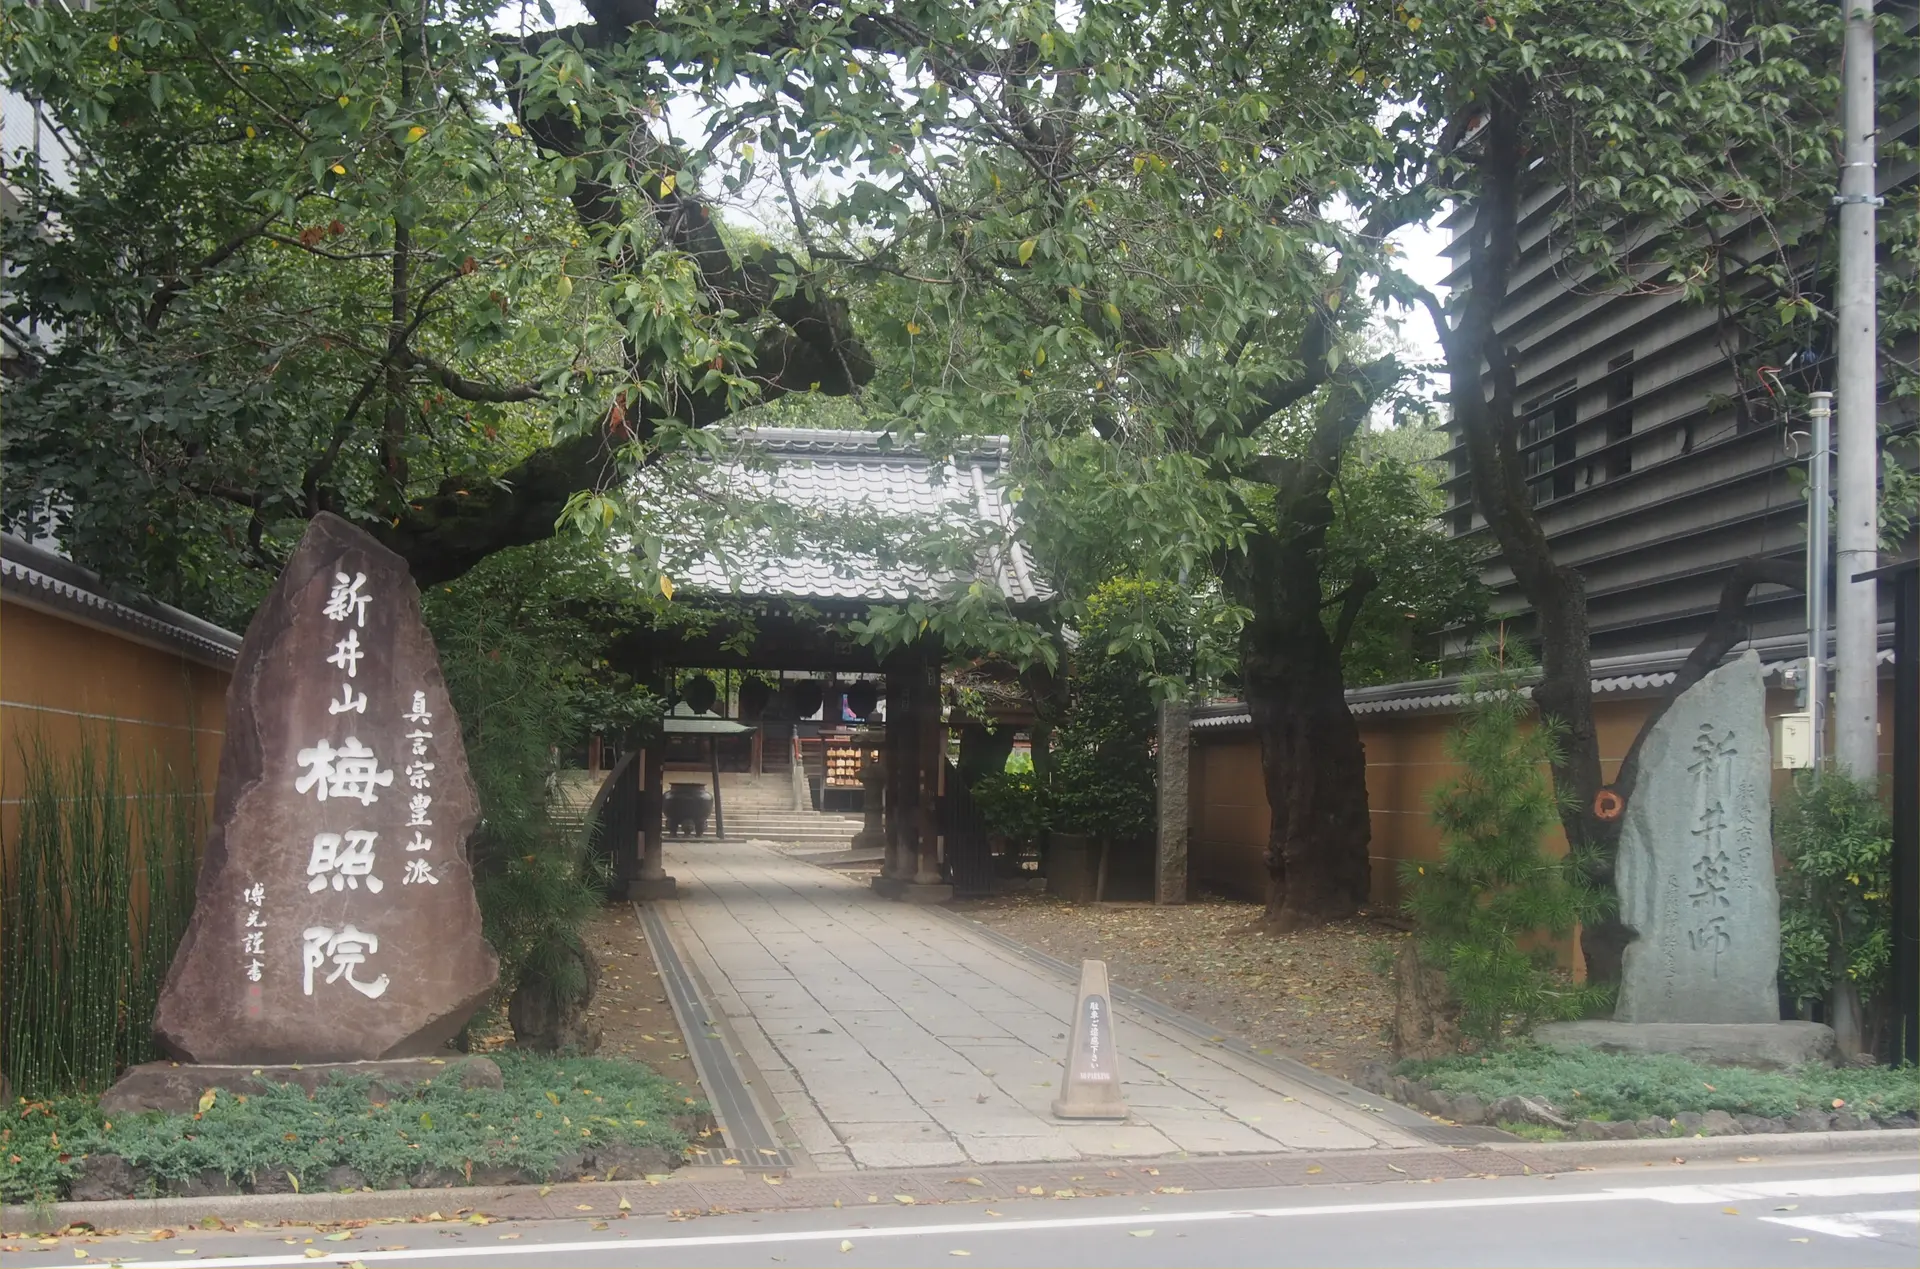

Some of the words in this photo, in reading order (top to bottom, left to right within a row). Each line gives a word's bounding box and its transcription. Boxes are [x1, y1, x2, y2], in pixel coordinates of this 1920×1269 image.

[295, 571, 394, 999] 新井山梅照院
[402, 689, 439, 886] 真言宗豊山派
